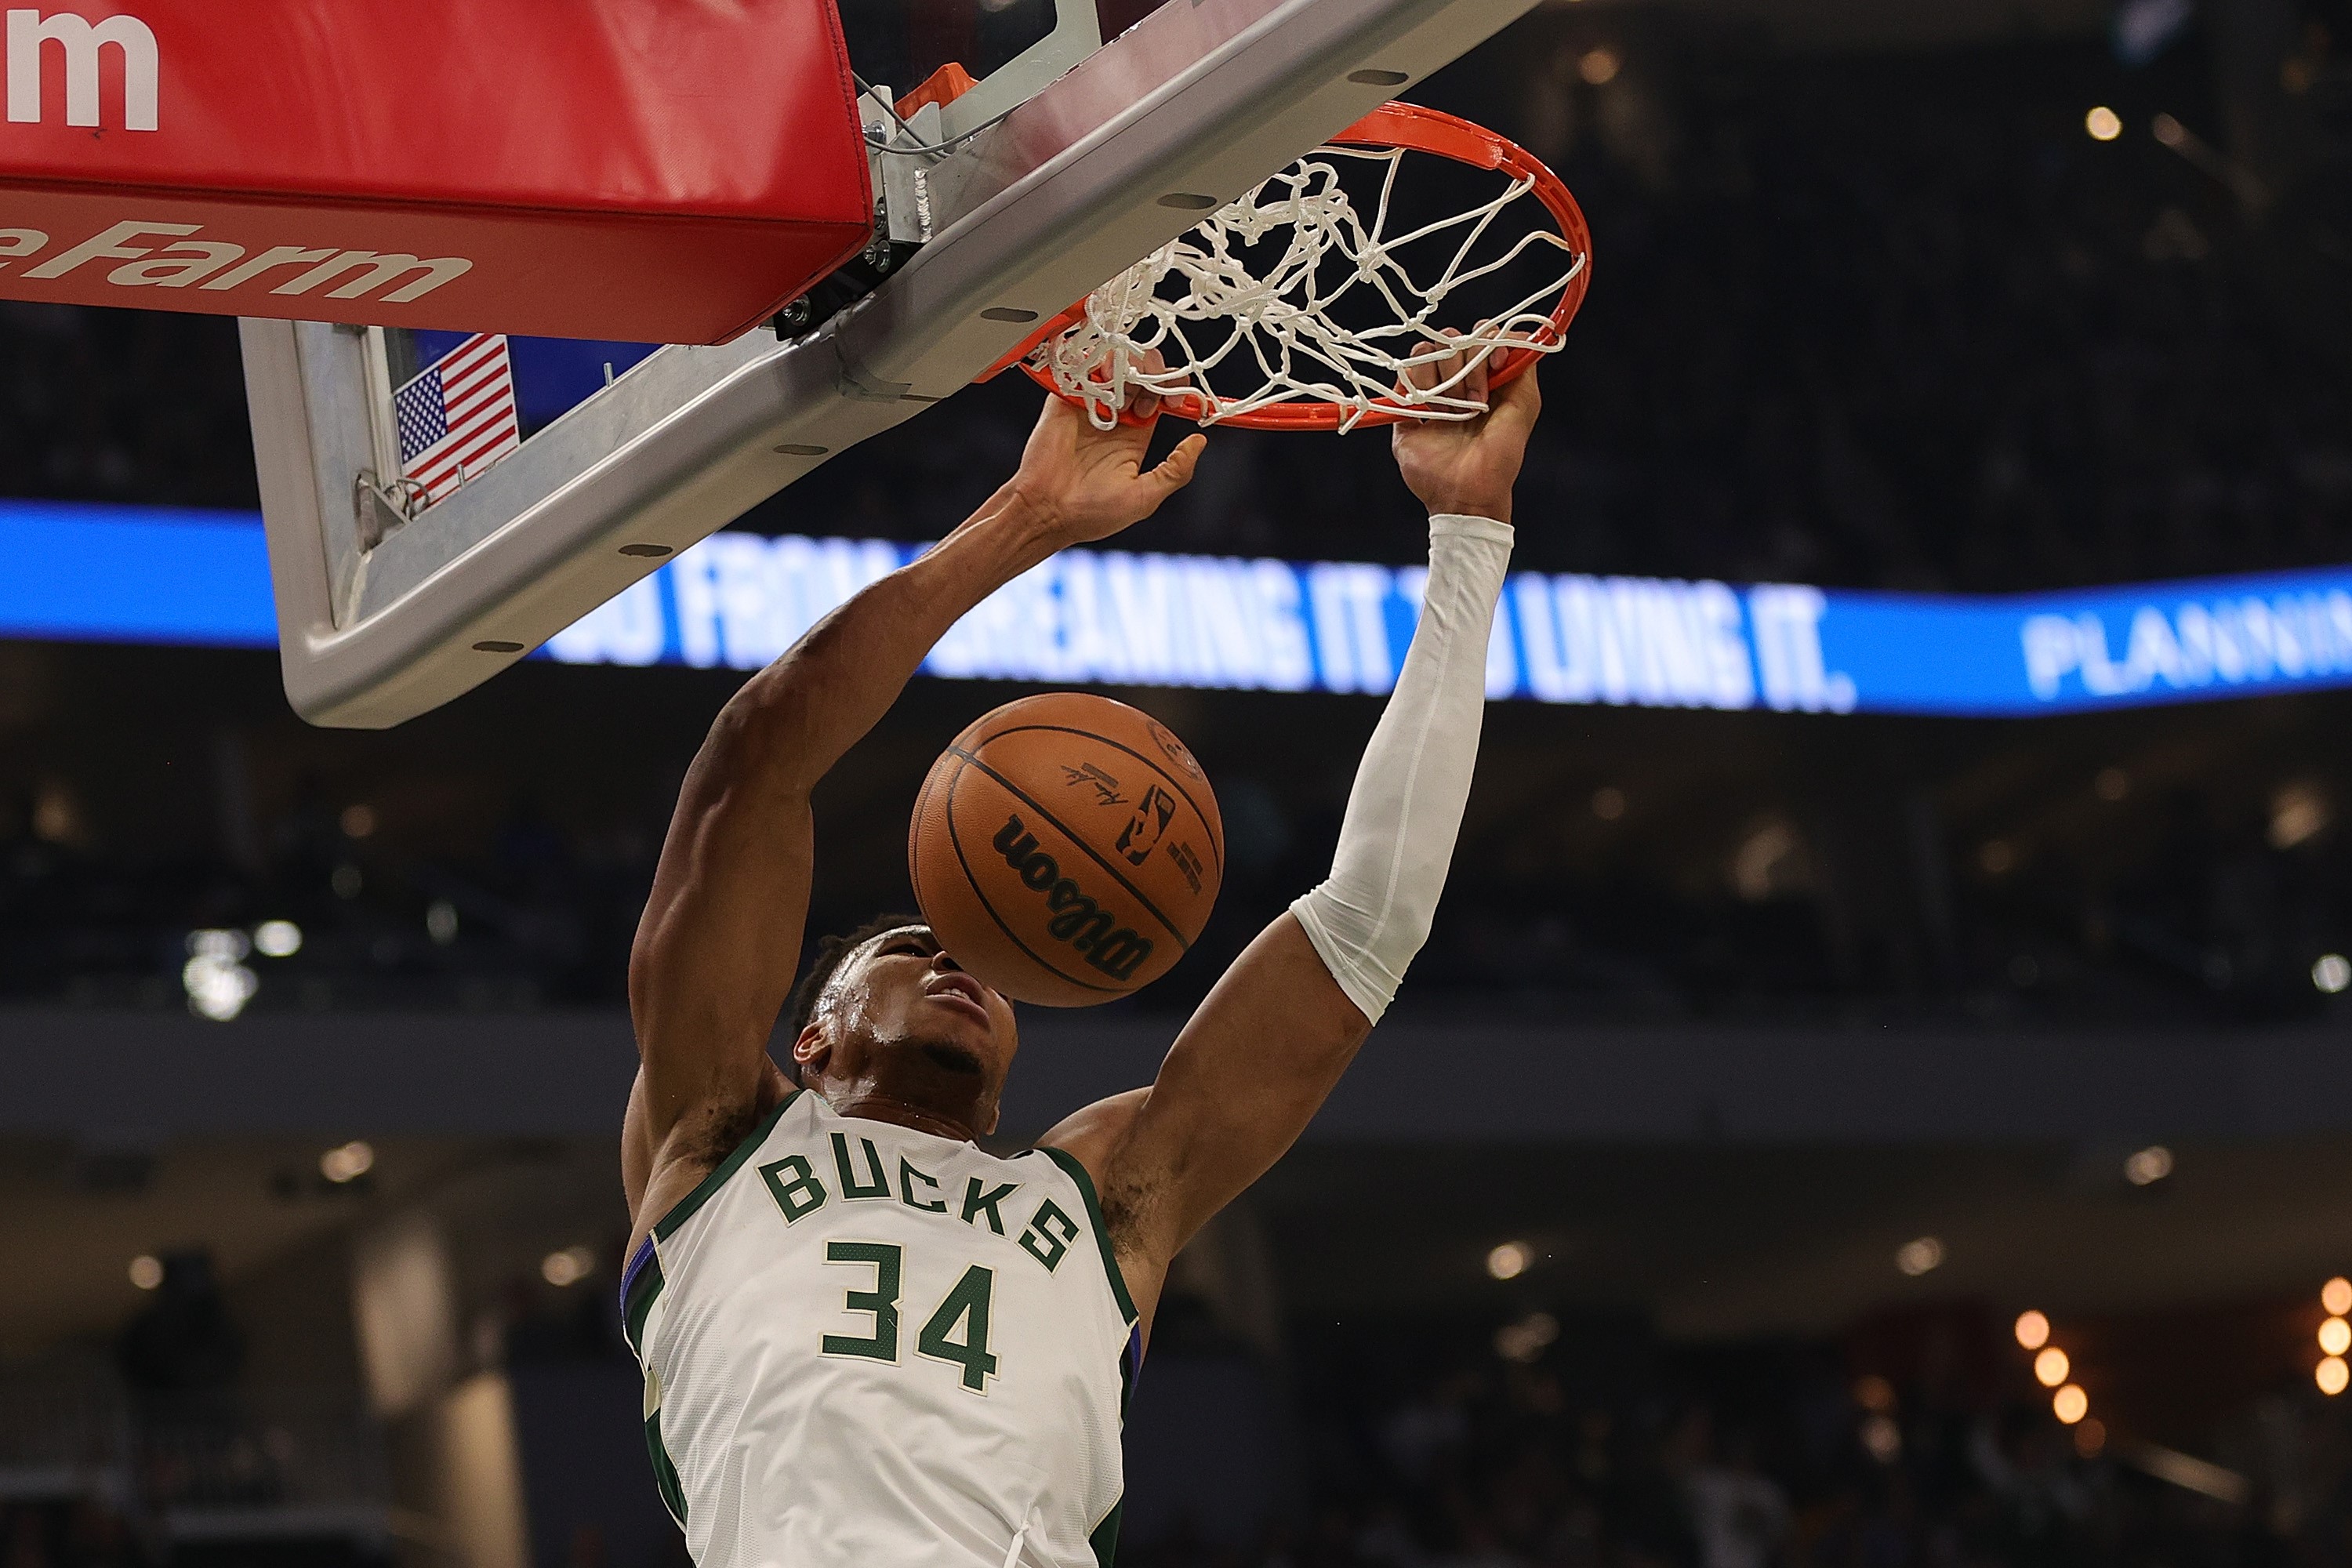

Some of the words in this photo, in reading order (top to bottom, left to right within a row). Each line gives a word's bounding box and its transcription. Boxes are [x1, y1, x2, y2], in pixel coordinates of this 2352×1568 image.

[20, 220, 474, 303] Farm
[925, 547, 1313, 693] REAMING
[1307, 559, 1395, 696] IT
[993, 813, 1154, 982] Wilson
[753, 1131, 1083, 1279] BUCKS
[816, 1238, 1003, 1398] 34
